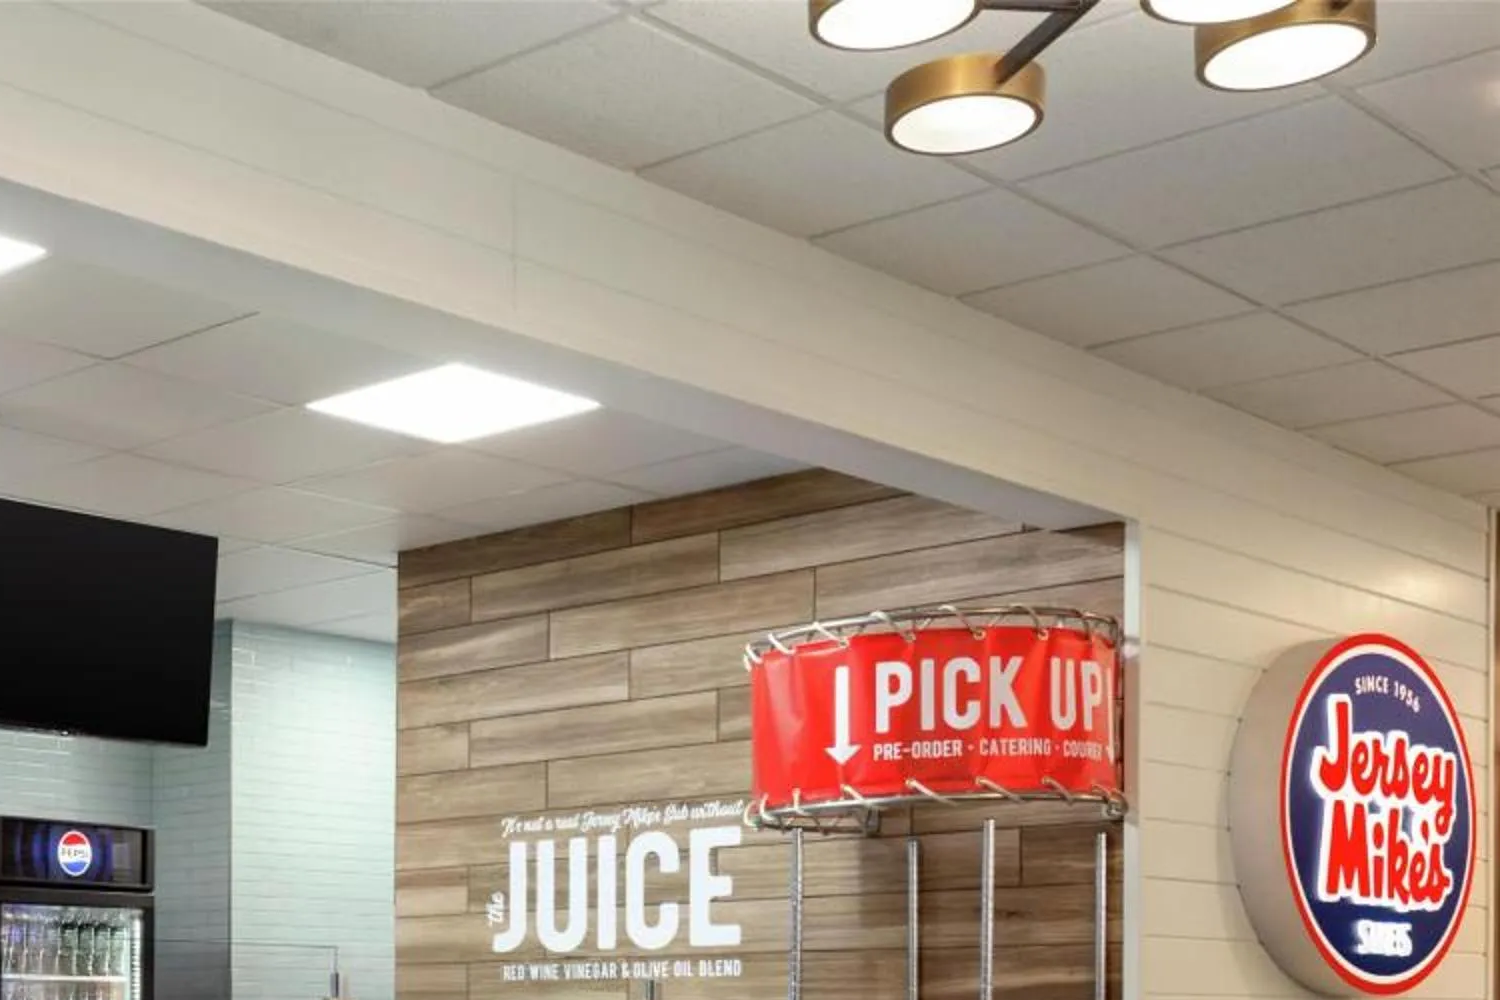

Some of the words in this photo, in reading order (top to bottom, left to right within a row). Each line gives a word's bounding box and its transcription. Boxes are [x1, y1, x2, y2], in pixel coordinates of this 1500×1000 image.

[875, 656, 1028, 733] PICK
[1051, 657, 1103, 731] UP
[1355, 674, 1389, 695] SINCE
[1394, 680, 1420, 713] 1956
[873, 739, 963, 762] PRE-ORDER
[979, 737, 1051, 757] CATERING
[1318, 699, 1455, 836] Jersey
[690, 799, 744, 818] without
[1324, 798, 1452, 906] Mike's
[492, 826, 742, 952] JUICE
[485, 891, 504, 927] the
[503, 963, 525, 981] RED
[530, 963, 560, 980] WINE
[563, 961, 618, 980] VINEGAR
[633, 960, 669, 977] OLIVE
[674, 960, 693, 976] OIL
[699, 959, 741, 977] BLEND
